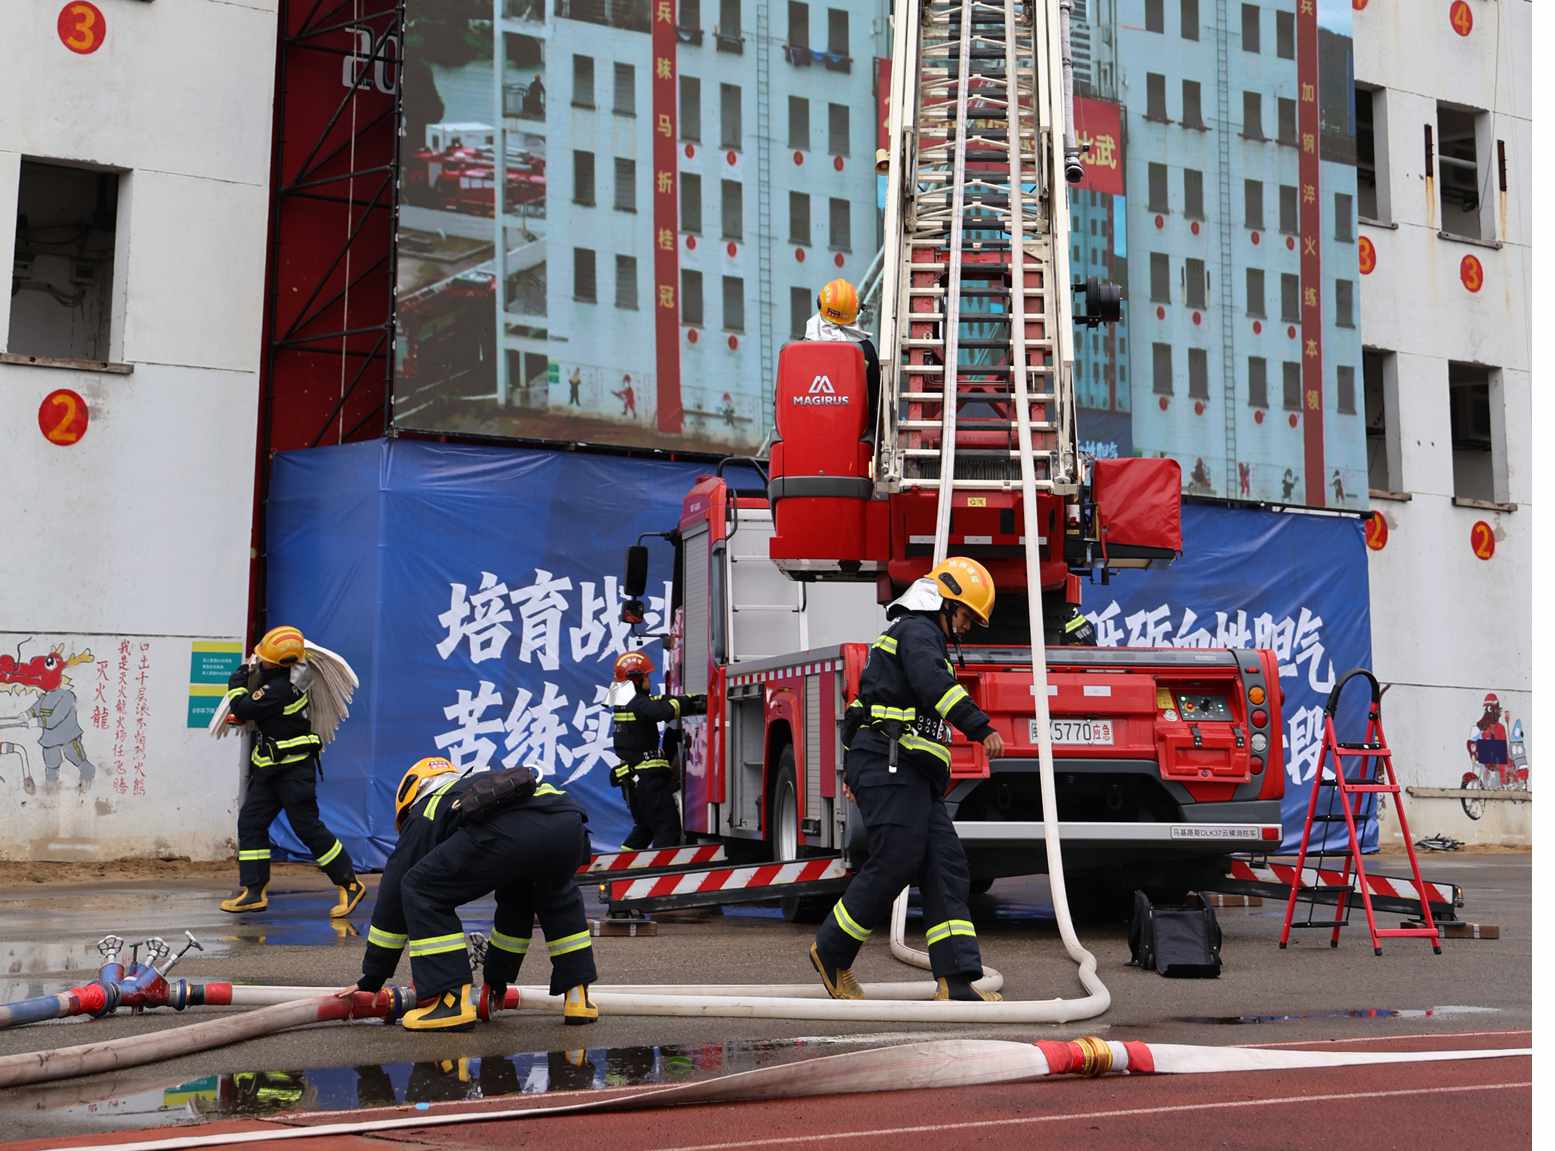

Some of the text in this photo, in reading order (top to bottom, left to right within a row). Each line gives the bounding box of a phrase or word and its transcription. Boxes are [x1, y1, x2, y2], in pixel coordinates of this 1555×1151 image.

[68, 5, 95, 48] 3
[1454, 4, 1469, 35] 4
[1465, 259, 1479, 289] 3
[793, 395, 849, 405] MAGIRUS
[51, 395, 77, 443] 2
[1372, 513, 1386, 548] 2
[1476, 525, 1491, 559] 2
